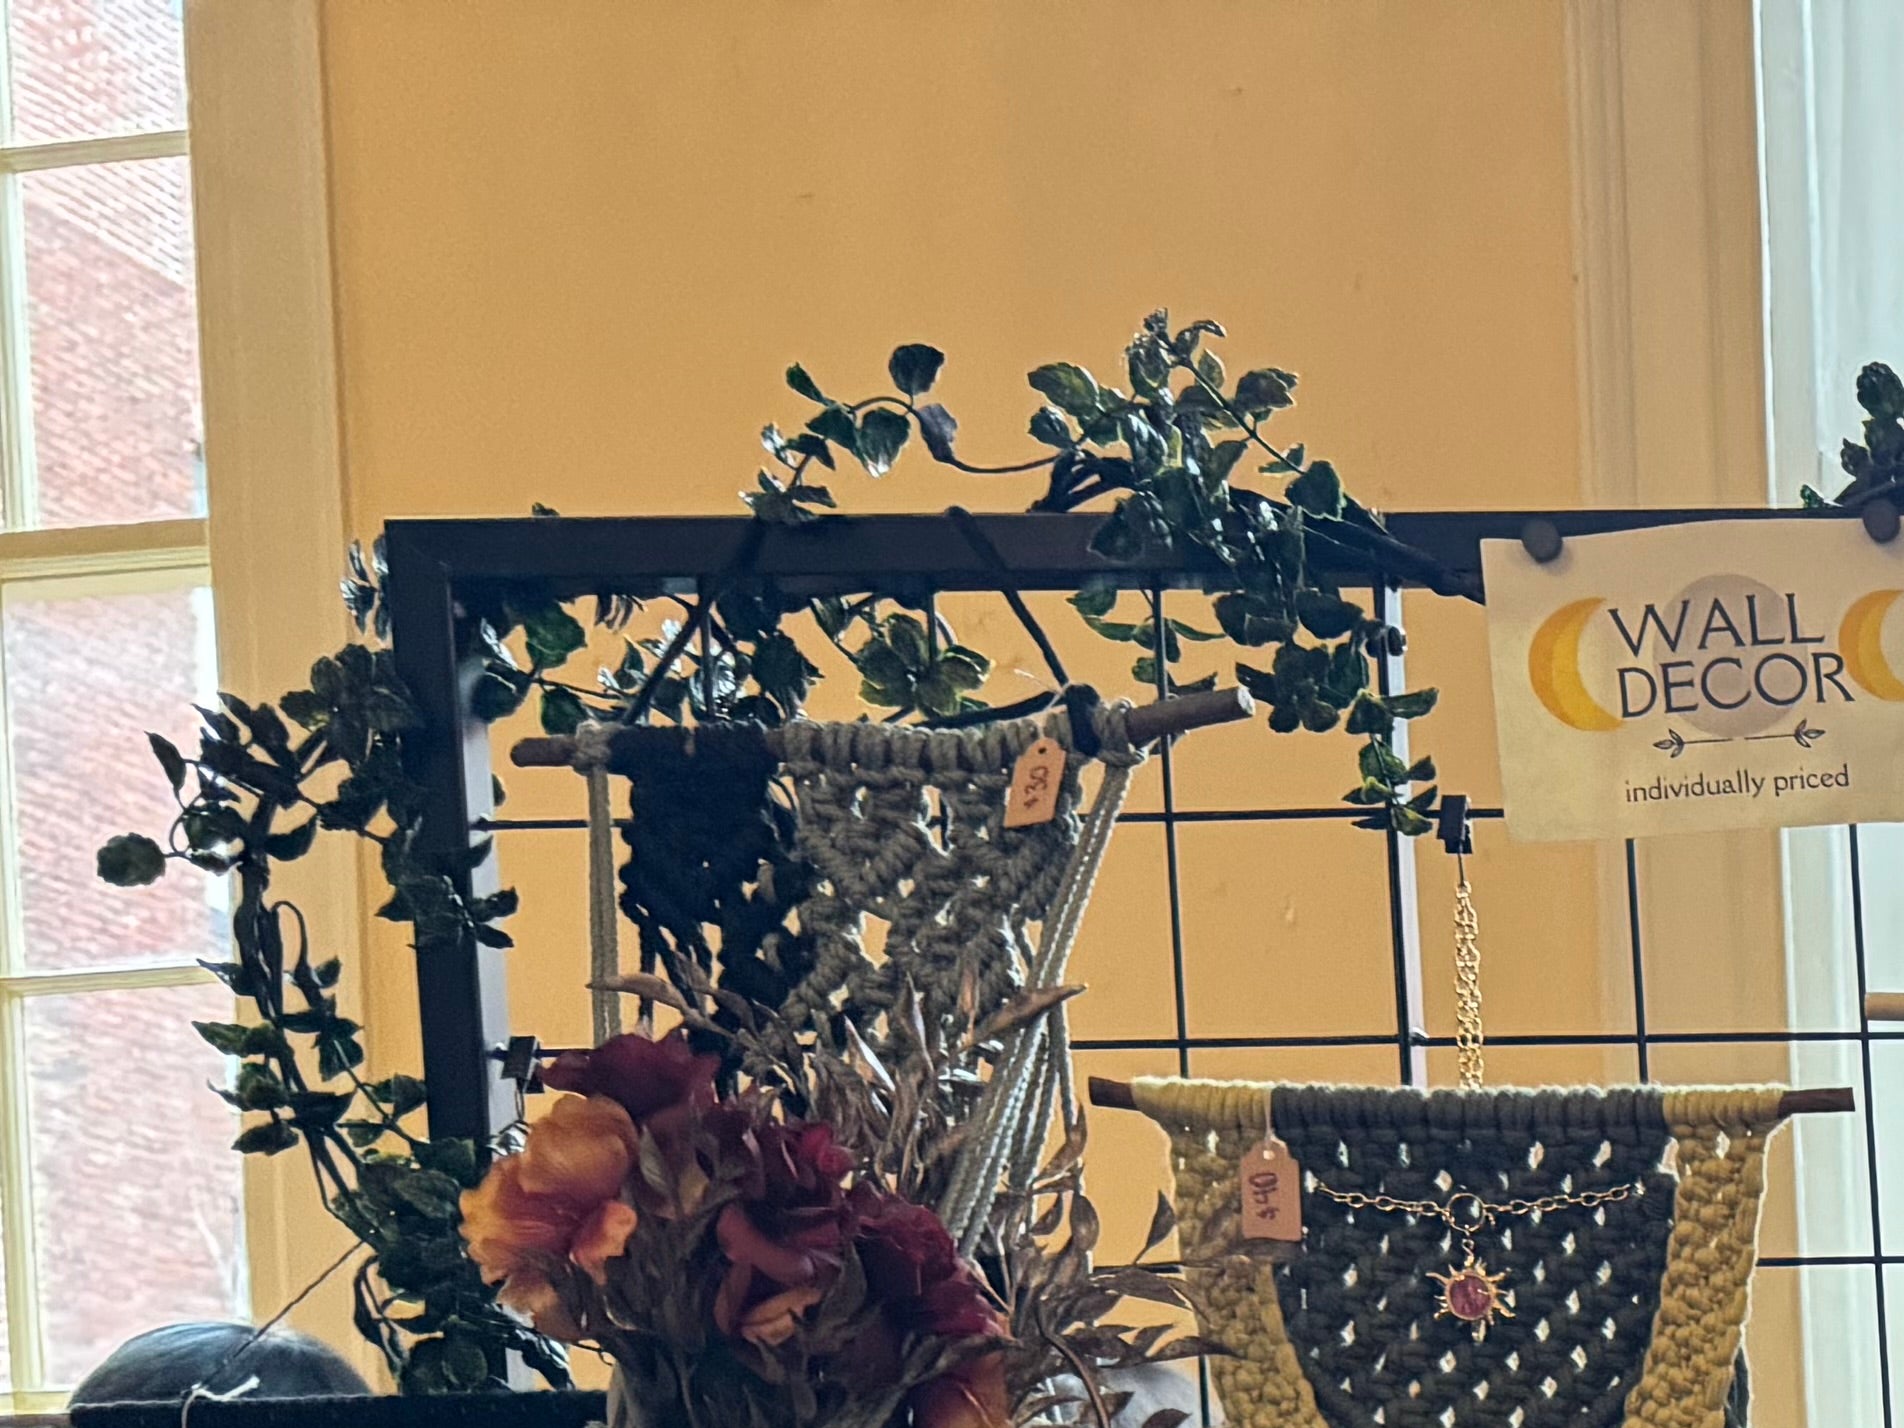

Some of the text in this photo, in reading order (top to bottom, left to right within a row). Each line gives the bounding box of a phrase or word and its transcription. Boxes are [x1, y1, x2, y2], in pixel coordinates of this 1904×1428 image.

[1609, 593, 1825, 656] WALL
[1617, 653, 1855, 718] DECOR
[1625, 764, 1850, 803] individually priced
[1248, 1172, 1280, 1220] $40
